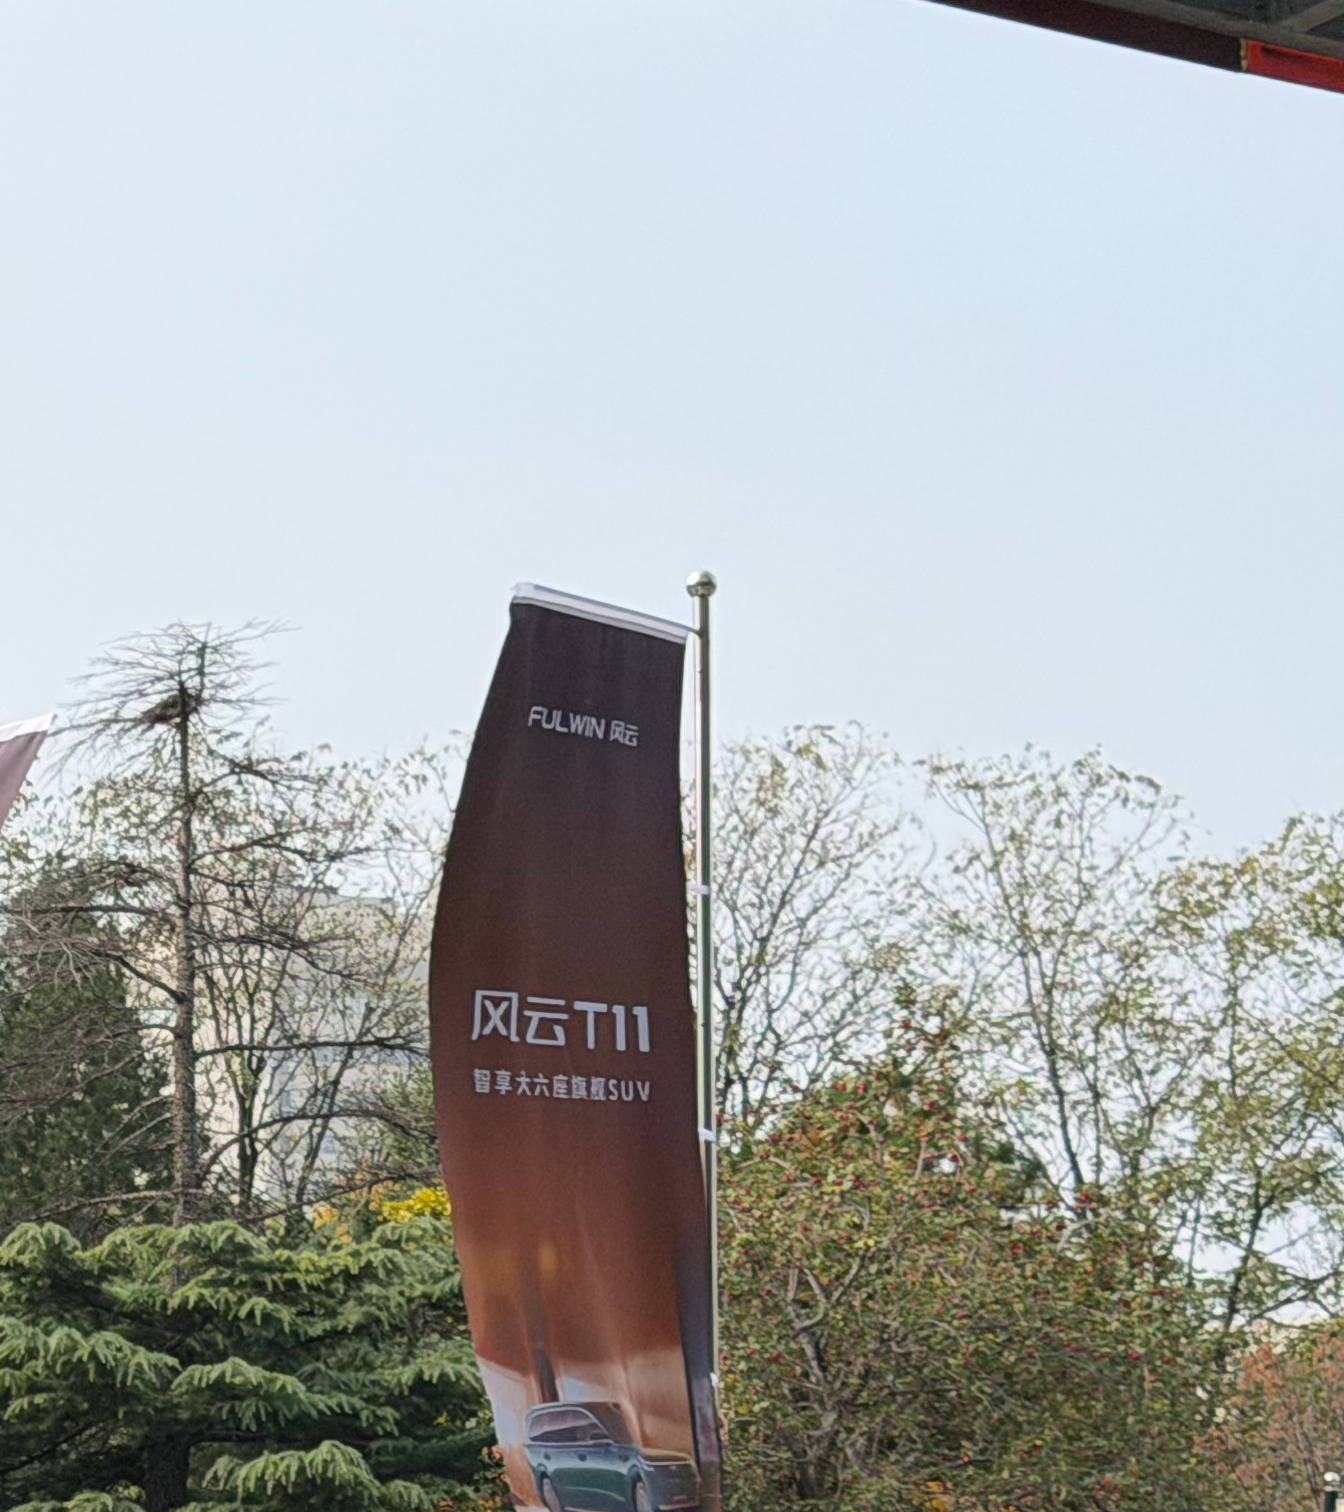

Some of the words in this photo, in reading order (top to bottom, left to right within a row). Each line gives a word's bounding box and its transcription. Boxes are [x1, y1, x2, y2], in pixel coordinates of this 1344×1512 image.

[528, 705, 606, 740] FULWIN
[609, 719, 640, 747] 风云
[470, 989, 651, 1053] 风云T11
